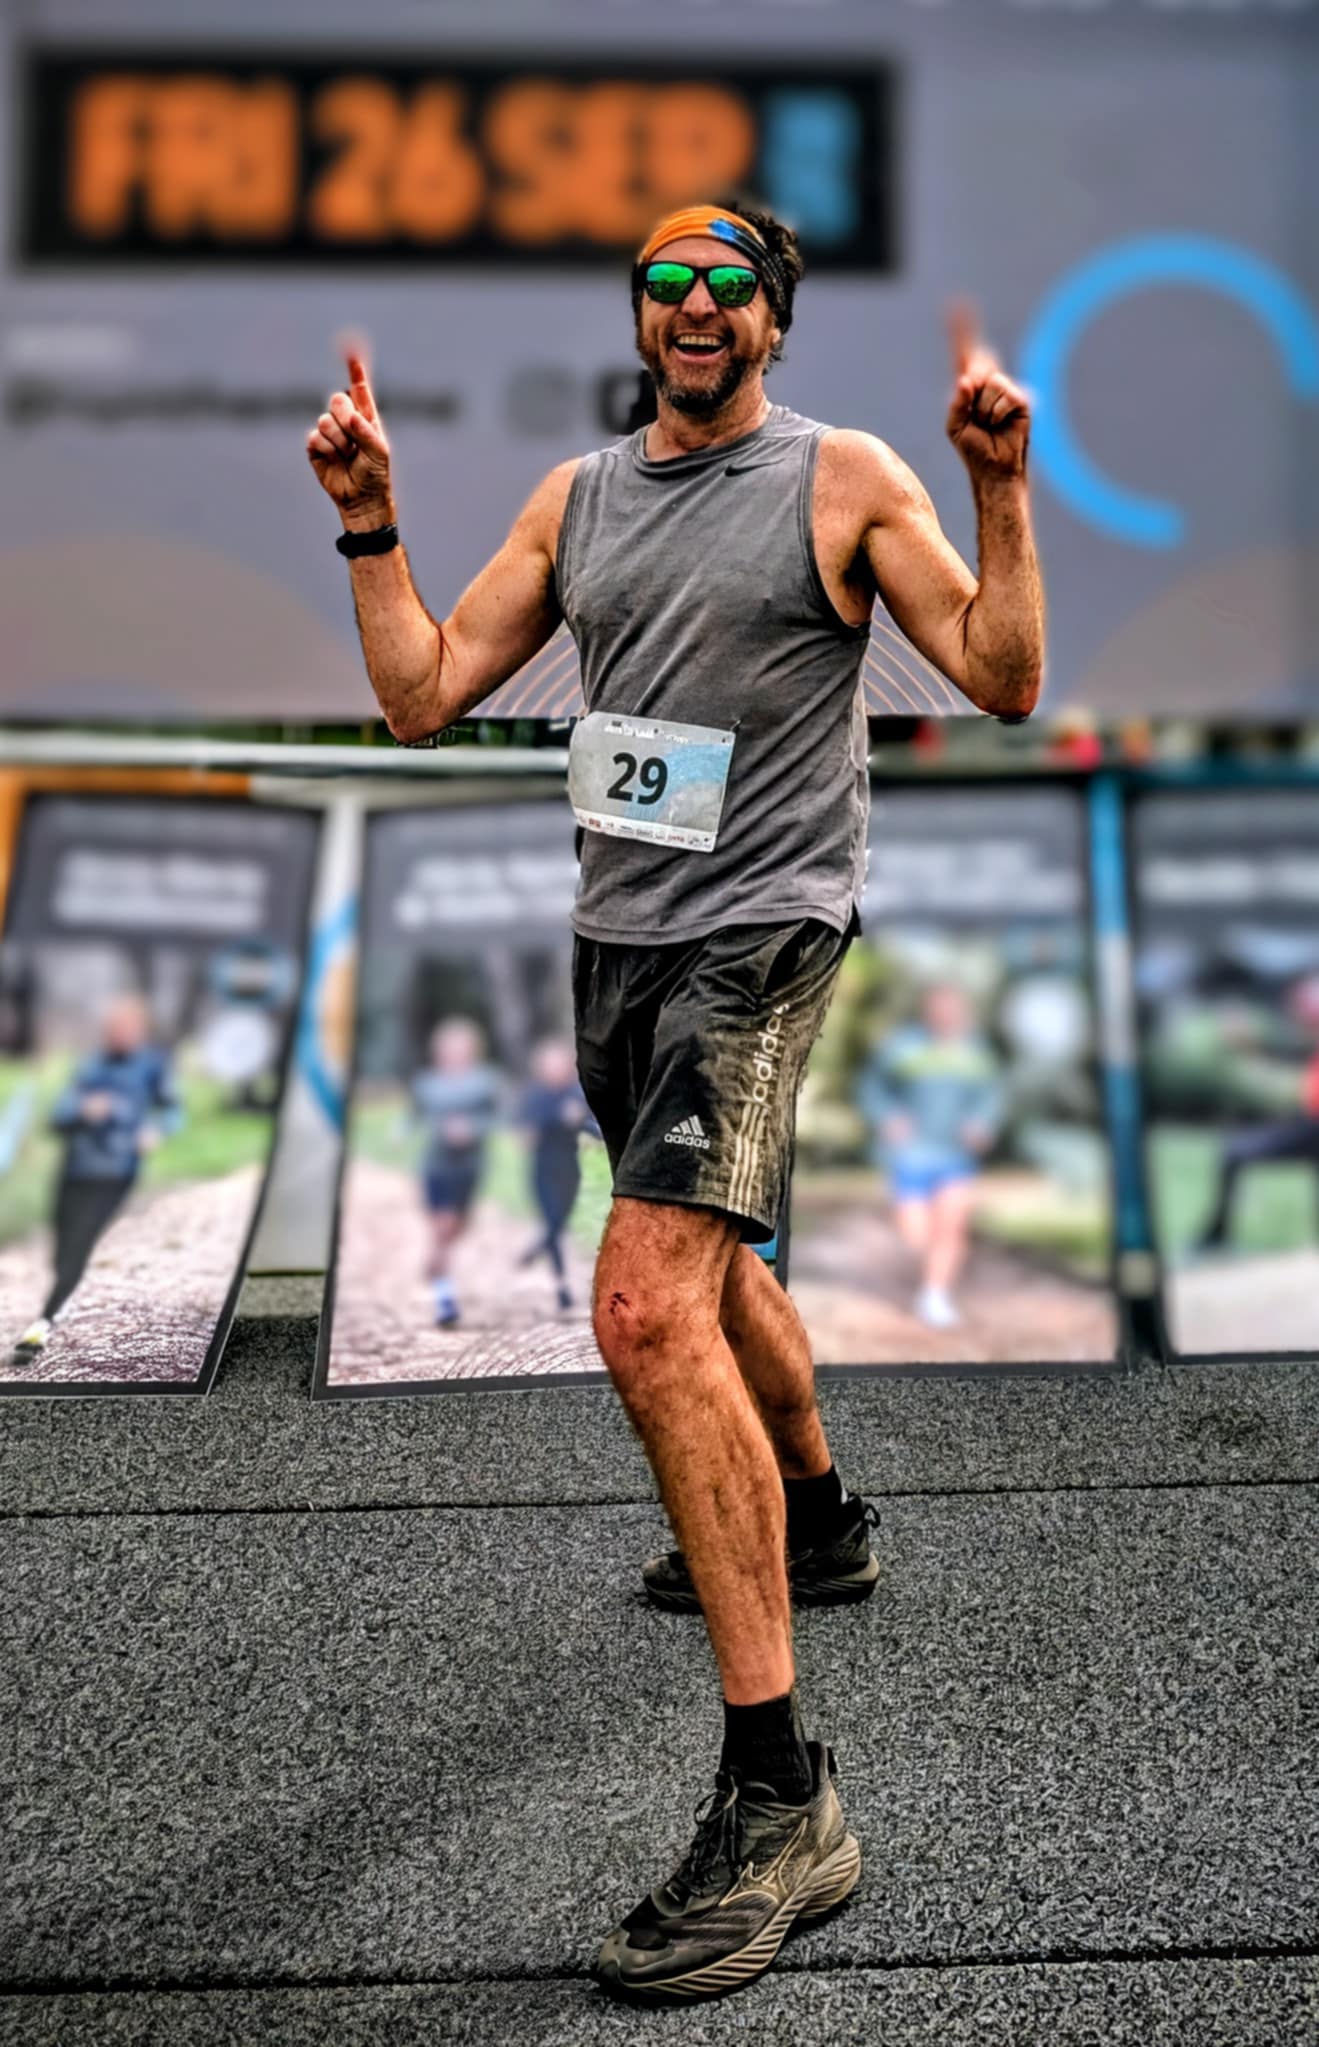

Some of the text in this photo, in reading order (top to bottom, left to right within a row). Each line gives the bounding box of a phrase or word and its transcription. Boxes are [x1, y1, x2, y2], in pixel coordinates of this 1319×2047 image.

[72, 75, 298, 239] FRI
[309, 74, 484, 242] 26
[485, 77, 755, 244] SEP
[606, 752, 668, 805] 29
[753, 1003, 789, 1103] adidas
[664, 1131, 710, 1149] adidas
